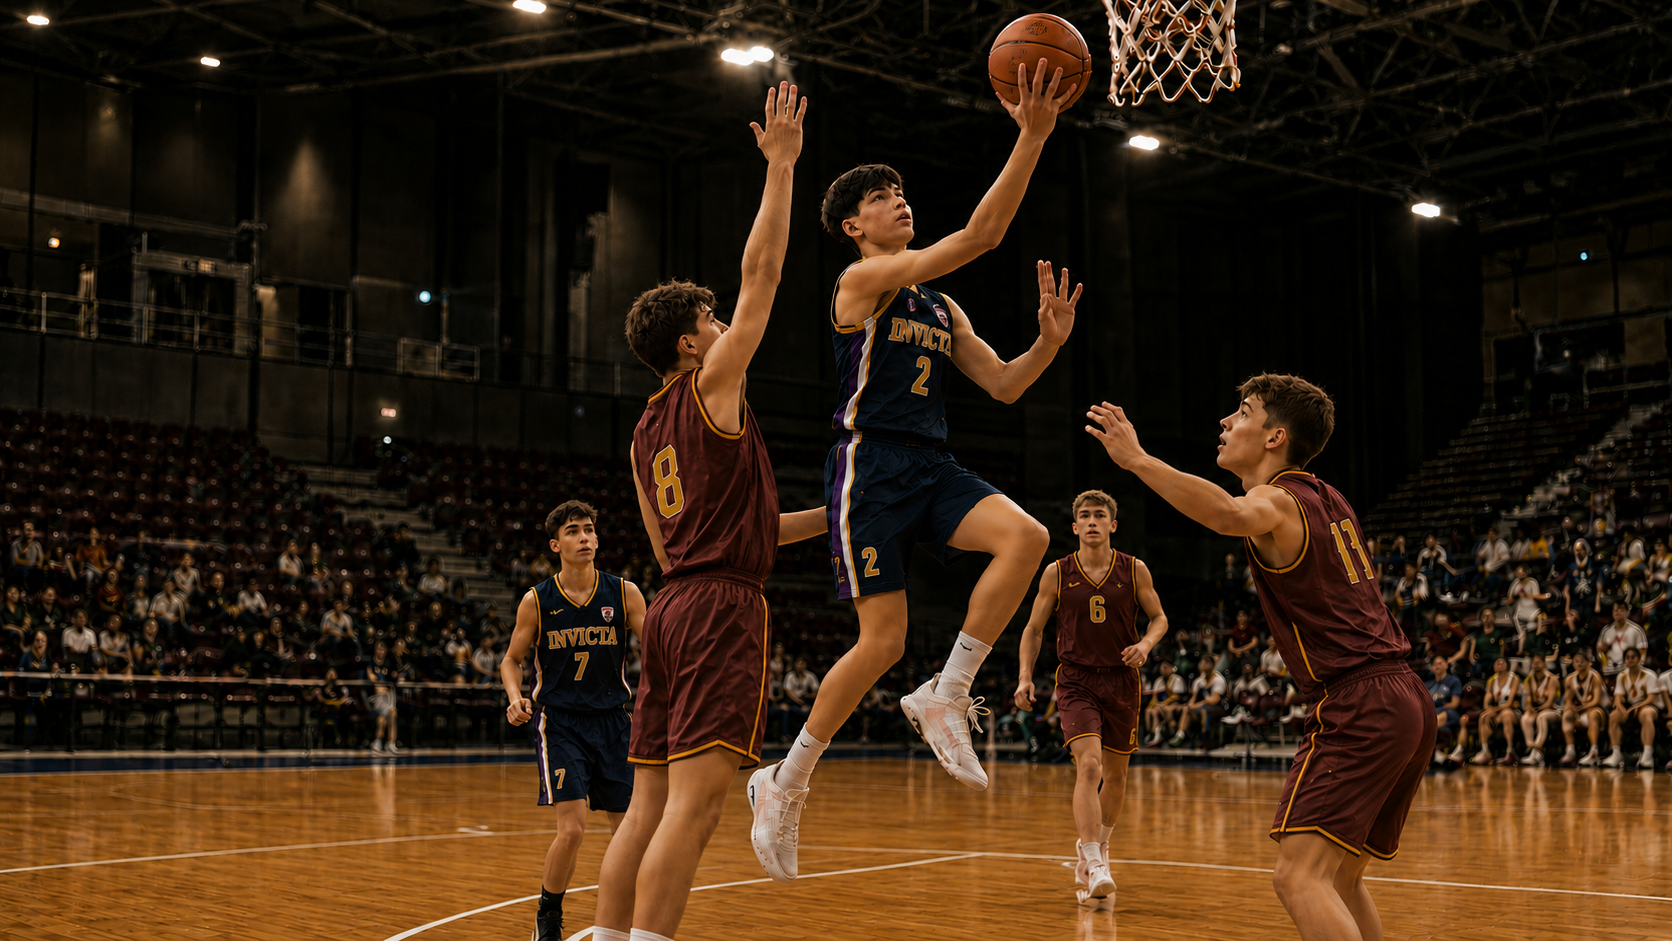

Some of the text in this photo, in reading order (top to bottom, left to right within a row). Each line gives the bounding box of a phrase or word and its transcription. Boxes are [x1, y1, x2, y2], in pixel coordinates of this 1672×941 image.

[888, 317, 951, 357] INVICTA
[911, 355, 931, 396] 2
[653, 444, 685, 519] 8
[861, 546, 880, 577] 2
[1089, 595, 1106, 623] 6
[546, 626, 618, 649] INVICTA
[574, 651, 589, 681] 7
[554, 768, 566, 789] 7
